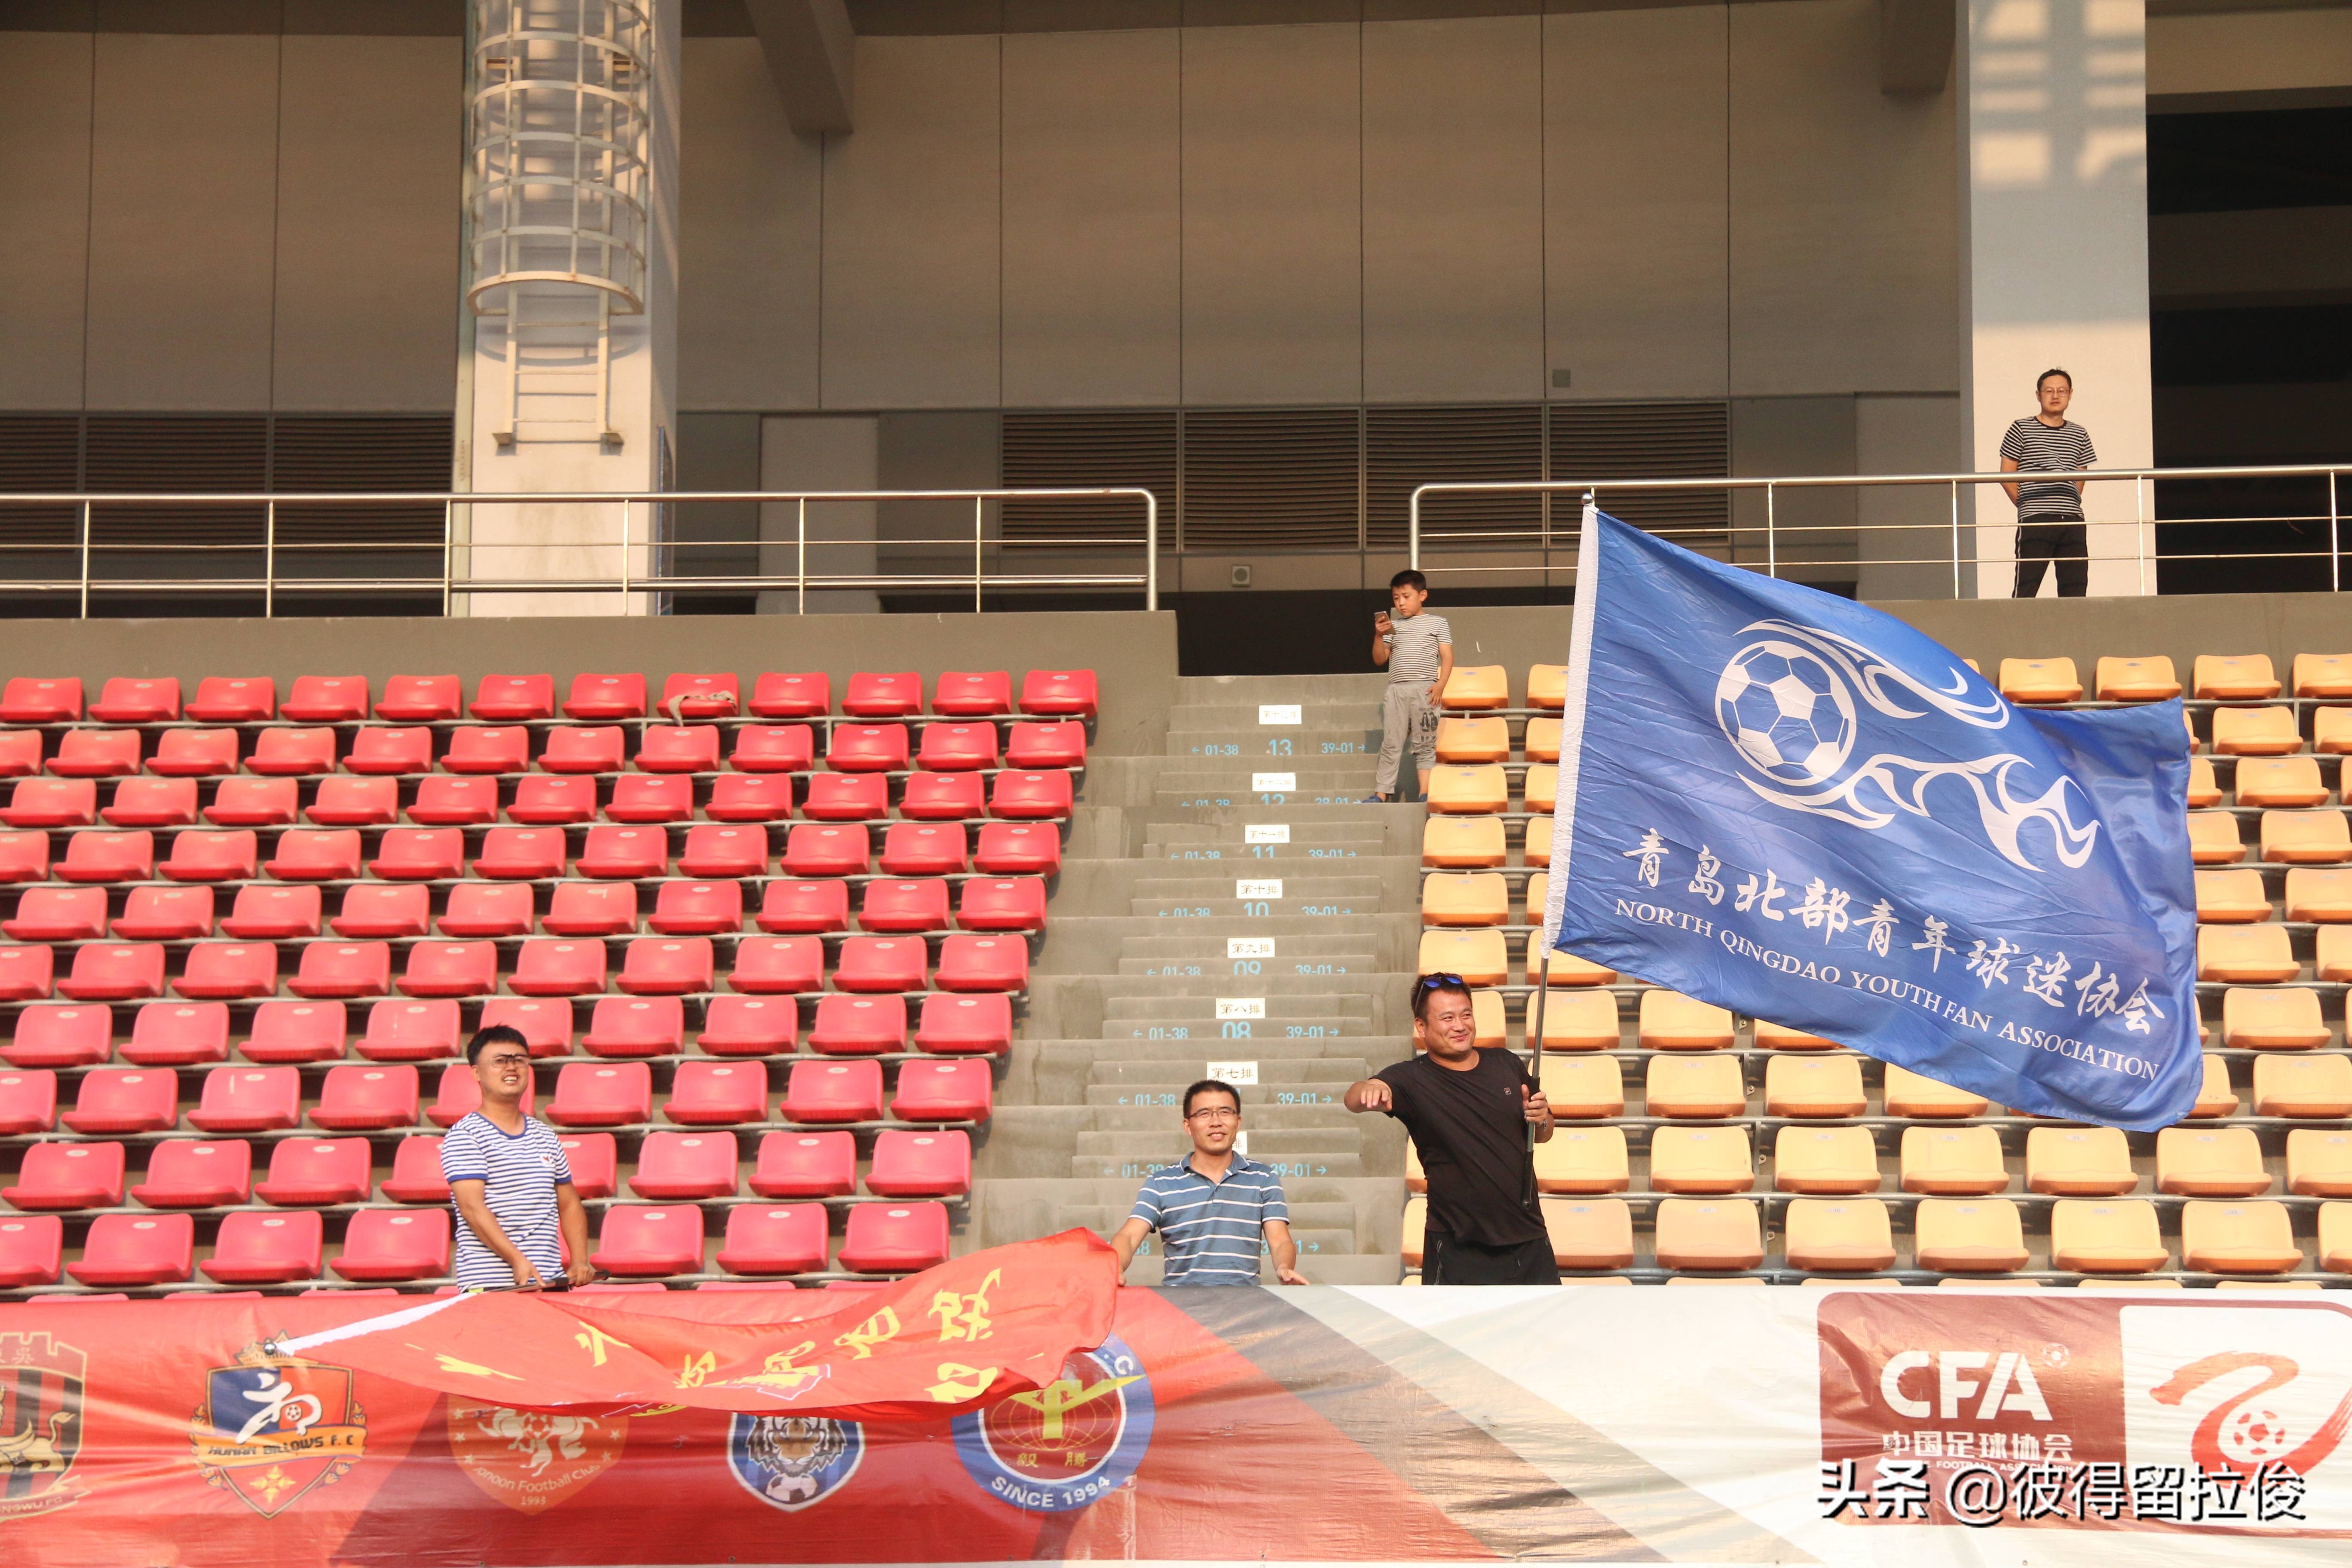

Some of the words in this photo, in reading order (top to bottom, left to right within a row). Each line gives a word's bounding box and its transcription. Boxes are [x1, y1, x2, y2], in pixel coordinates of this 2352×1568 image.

[1205, 744, 1238, 755] 01-38
[1269, 739, 1292, 755] 13
[1321, 743, 1353, 753] 39-01
[1253, 845, 1274, 858] 11
[1240, 883, 1278, 895] 第十排
[1243, 902, 1269, 916] 10
[1623, 827, 2165, 1034] 青岛北部青年球迷协会
[1232, 943, 1271, 954] 第九排
[1234, 960, 1261, 975] 09
[1615, 899, 1713, 938] NORTH
[1720, 930, 1840, 983] QINGDAO
[1850, 971, 1942, 1012] YOUTH
[1942, 1000, 1993, 1032] FAN
[1997, 1022, 2159, 1081] ASSOCIATION
[1219, 1003, 1261, 1014] 第八排
[1149, 1028, 1188, 1039] 01-38
[1222, 1021, 1251, 1038] 08
[1286, 1026, 1324, 1038] 39-01
[1212, 1067, 1253, 1080] 第七排
[1135, 1094, 1176, 1106] 01-38
[1277, 1093, 1317, 1104] 39-01
[1880, 1351, 2053, 1421] CFA
[1882, 1430, 2073, 1461] 中国足球协会
[518, 1473, 572, 1492] Football
[572, 1465, 601, 1479] Club
[991, 1476, 1054, 1507] SINCE
[1062, 1476, 1110, 1505] 1994
